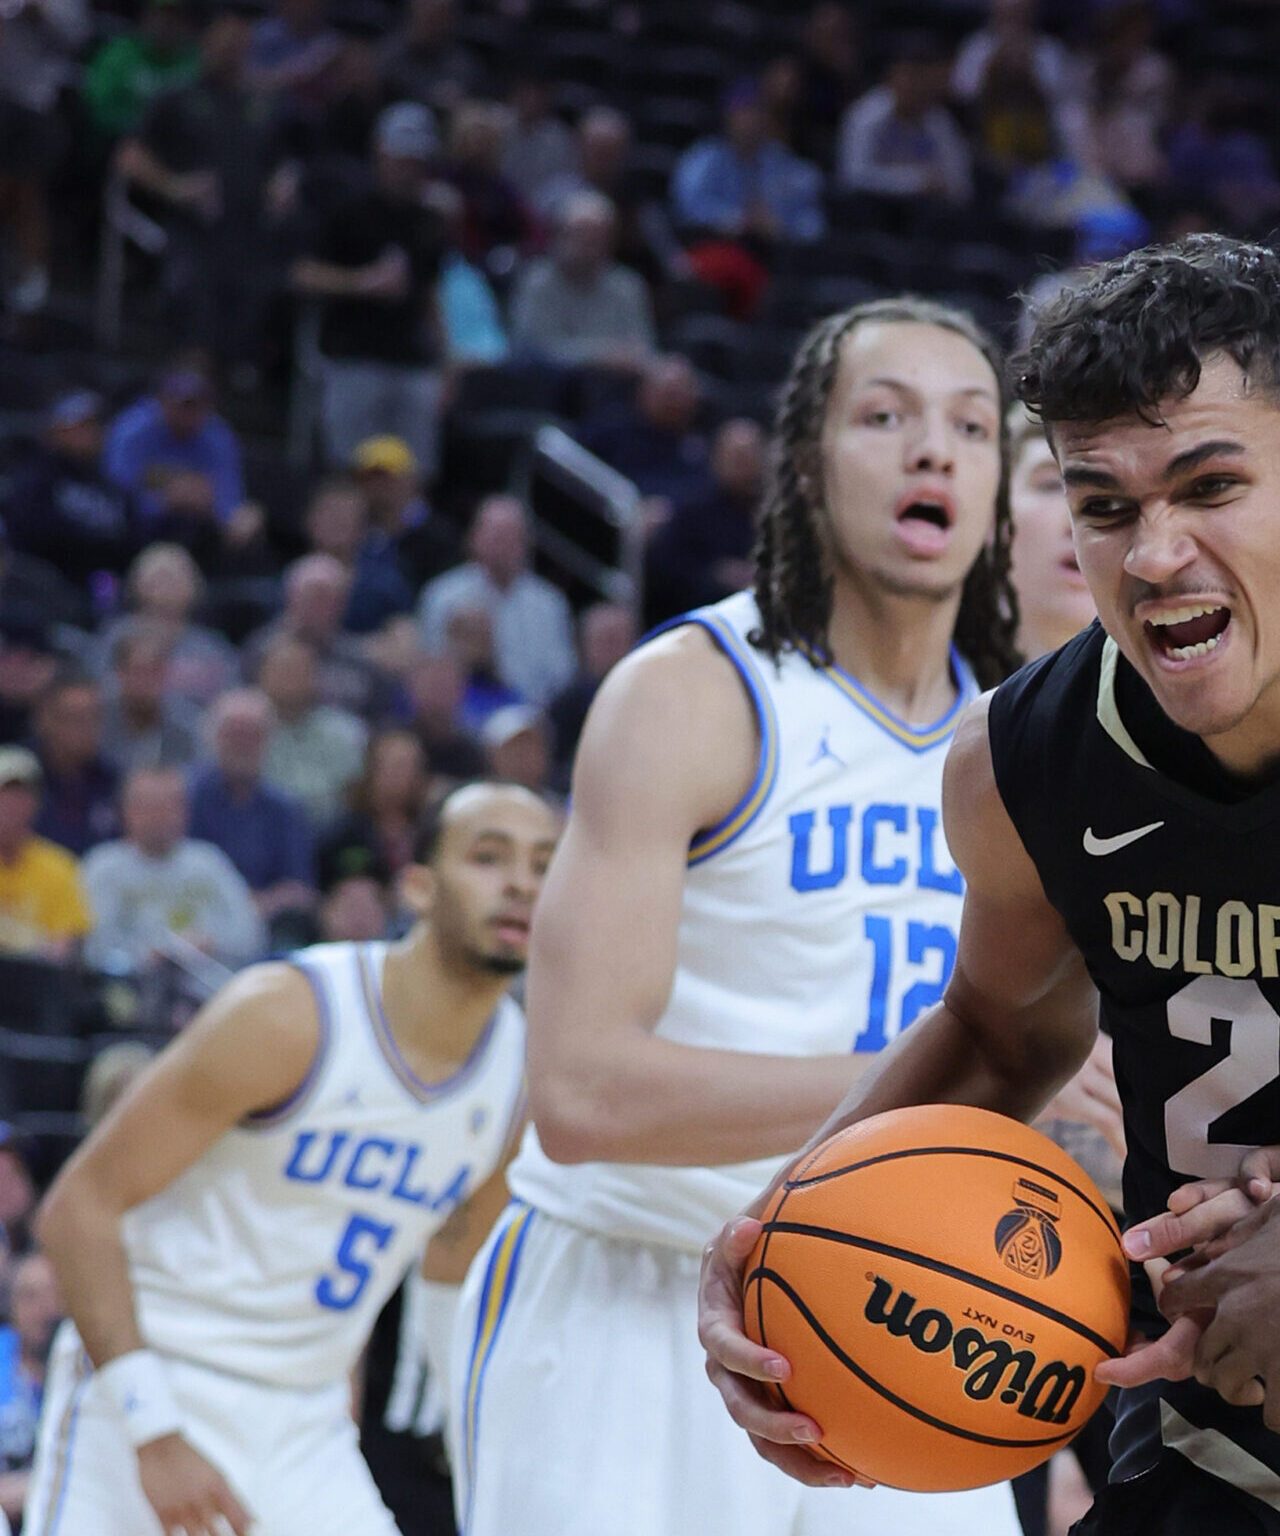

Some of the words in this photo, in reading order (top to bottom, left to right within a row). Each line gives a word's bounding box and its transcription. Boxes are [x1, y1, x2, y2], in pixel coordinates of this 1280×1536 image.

[789, 803, 964, 896] UCL
[853, 914, 958, 1053] 12
[315, 1214, 395, 1311] 5
[864, 1275, 1086, 1425] Wilson
[962, 1307, 998, 1328] NXT
[1002, 1324, 1035, 1344] EVO
